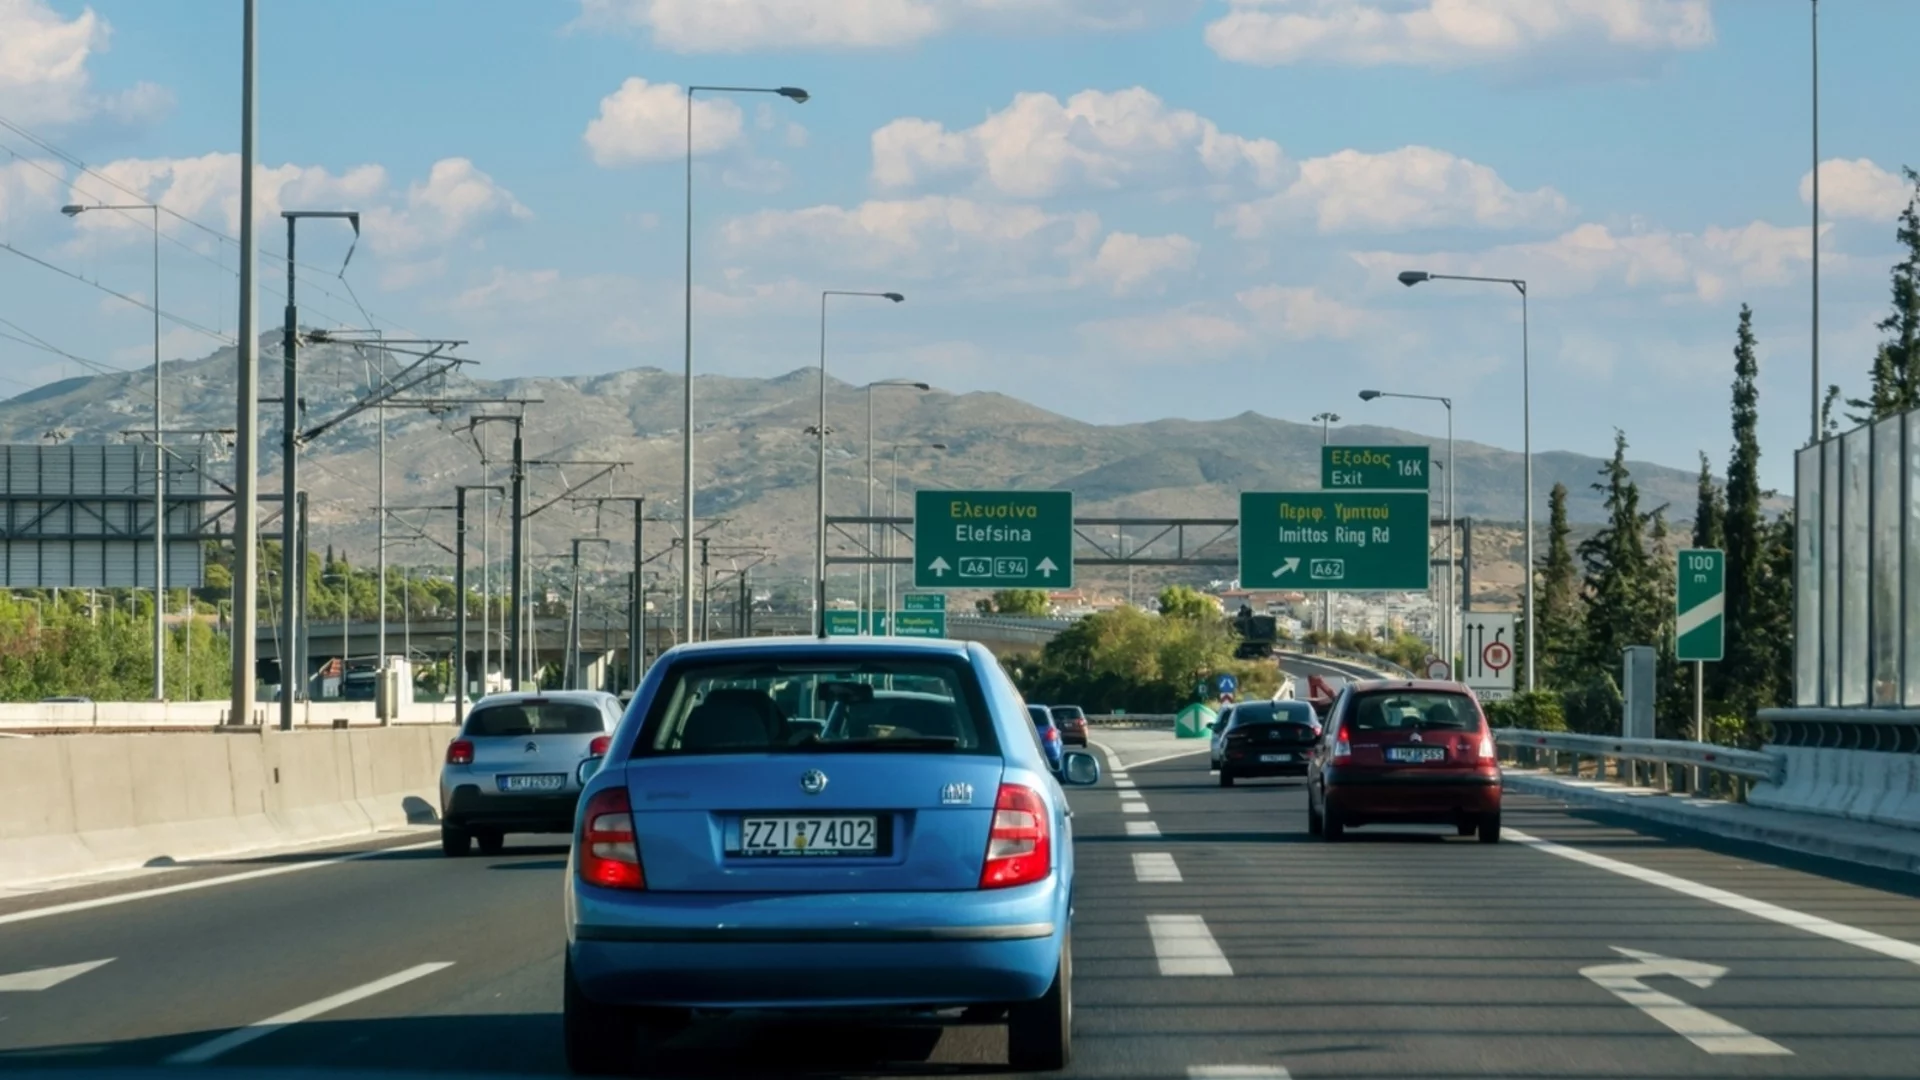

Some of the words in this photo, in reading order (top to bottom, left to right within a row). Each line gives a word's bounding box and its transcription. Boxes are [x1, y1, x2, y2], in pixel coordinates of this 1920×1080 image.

[1397, 459, 1422, 476] 16K
[1331, 470, 1362, 485] Exit
[950, 501, 1038, 518] Ελευσίνα
[955, 524, 1032, 542] Elefsina
[1279, 526, 1328, 543] Imittos
[1335, 526, 1366, 547] Ring
[1372, 526, 1390, 543] Rd
[966, 561, 985, 574] A6
[1314, 563, 1341, 576] A62
[1688, 555, 1714, 570] 100
[1694, 574, 1707, 583] m
[807, 820, 873, 848] 7402
